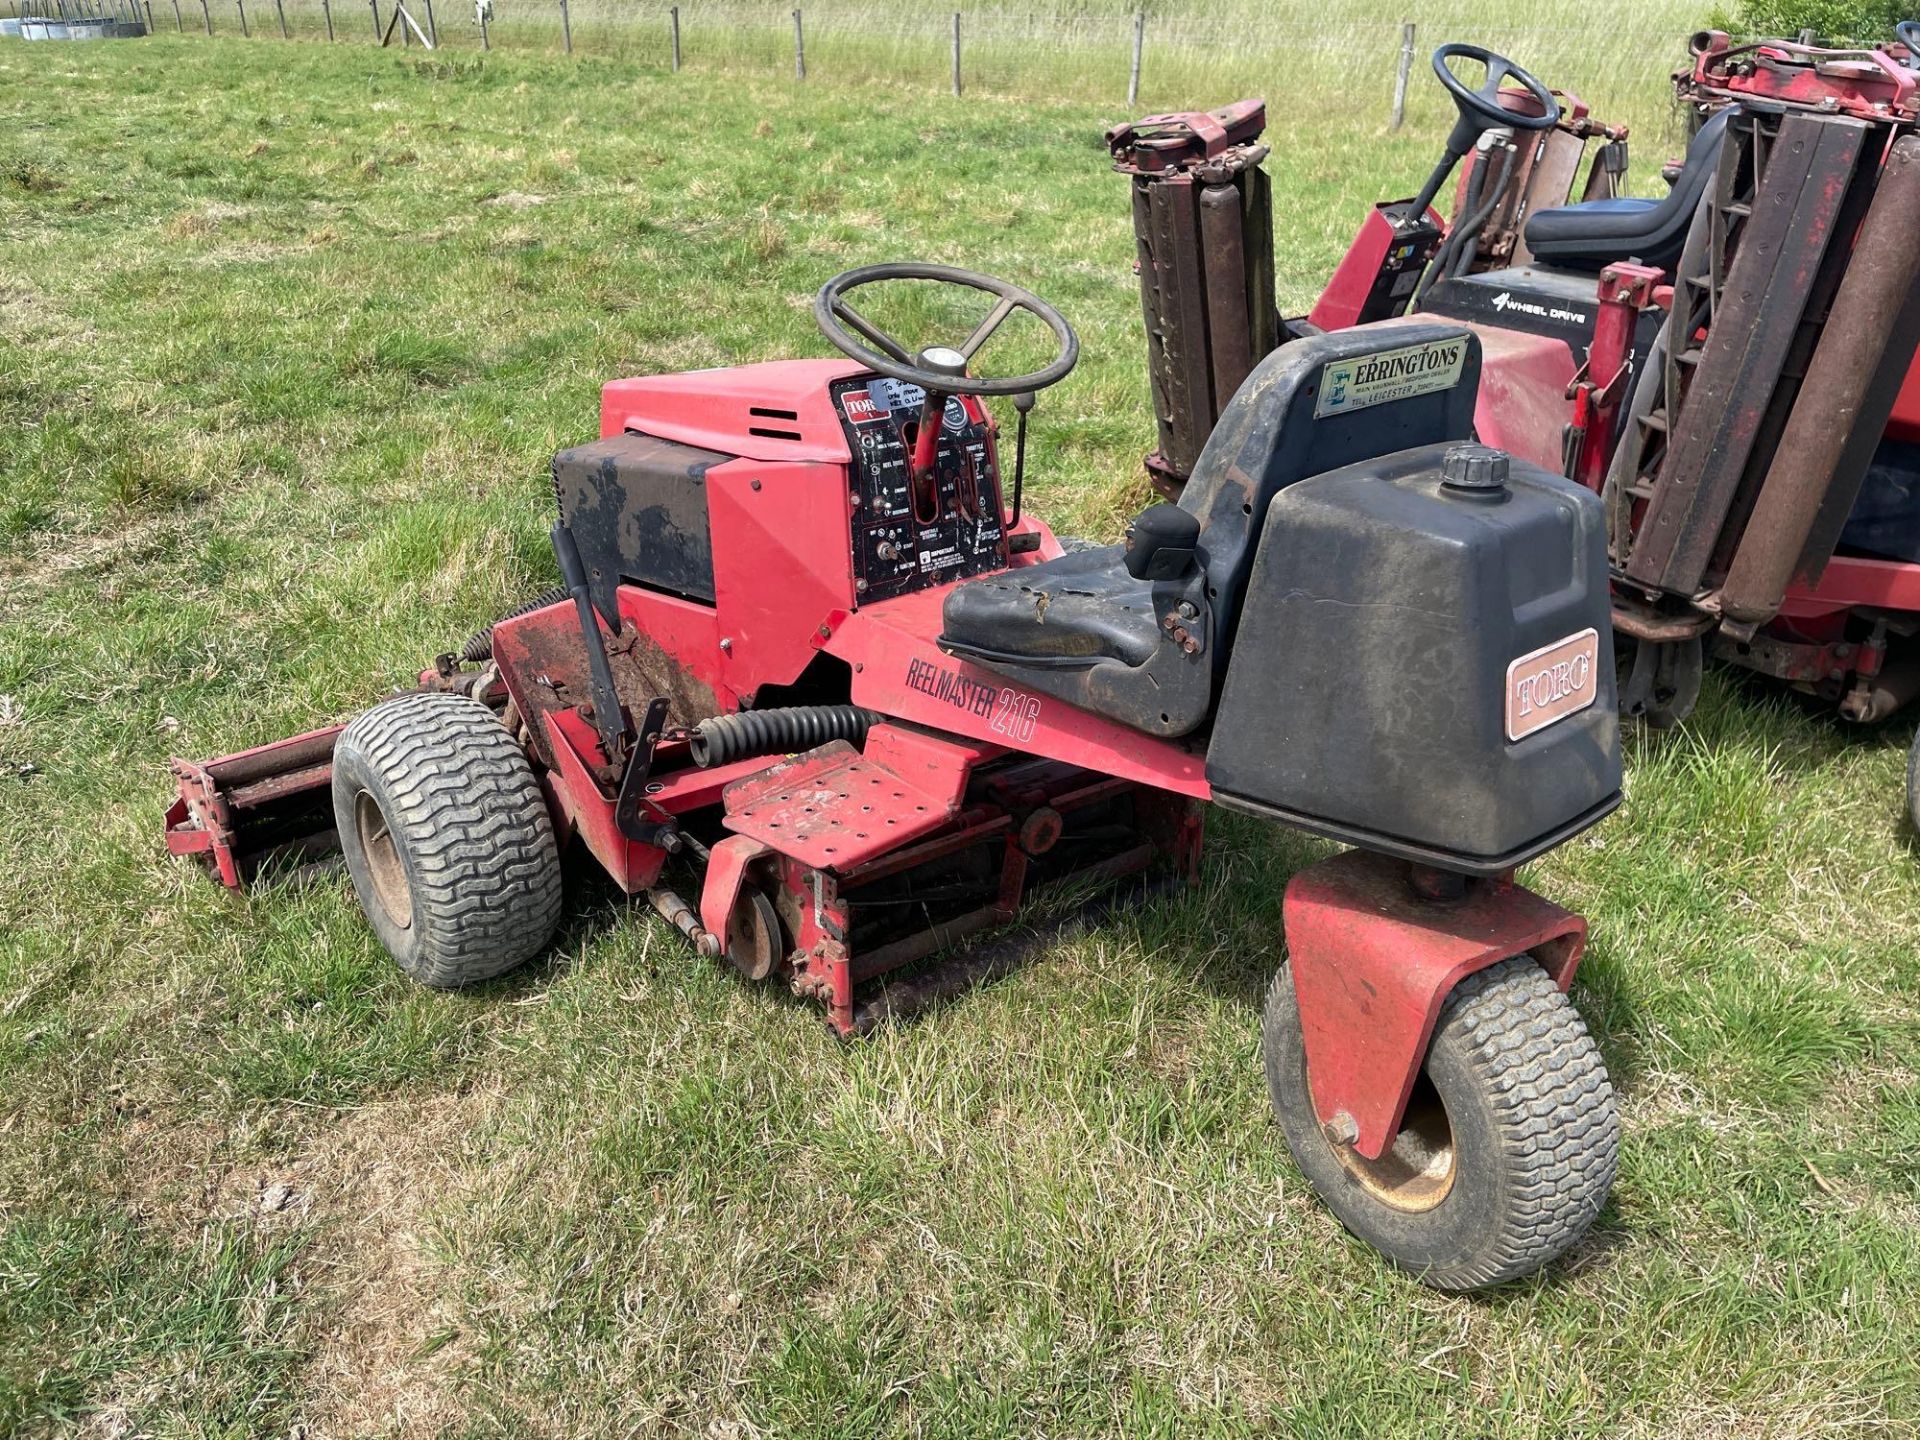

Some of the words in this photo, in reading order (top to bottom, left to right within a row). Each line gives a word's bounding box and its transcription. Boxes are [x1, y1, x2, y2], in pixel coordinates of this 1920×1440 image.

[1491, 292, 1511, 312] 4
[1506, 301, 1548, 316] WHEEL
[1549, 308, 1586, 324] DRIVE
[1353, 345, 1460, 386] ERRINGTONS
[847, 399, 878, 414] TOR
[1368, 385, 1413, 403] LEICESTER
[931, 547, 954, 557] IMPORTANT
[905, 657, 998, 720] REELMASTER
[991, 687, 1042, 743] 216
[1517, 653, 1589, 717] TORO
